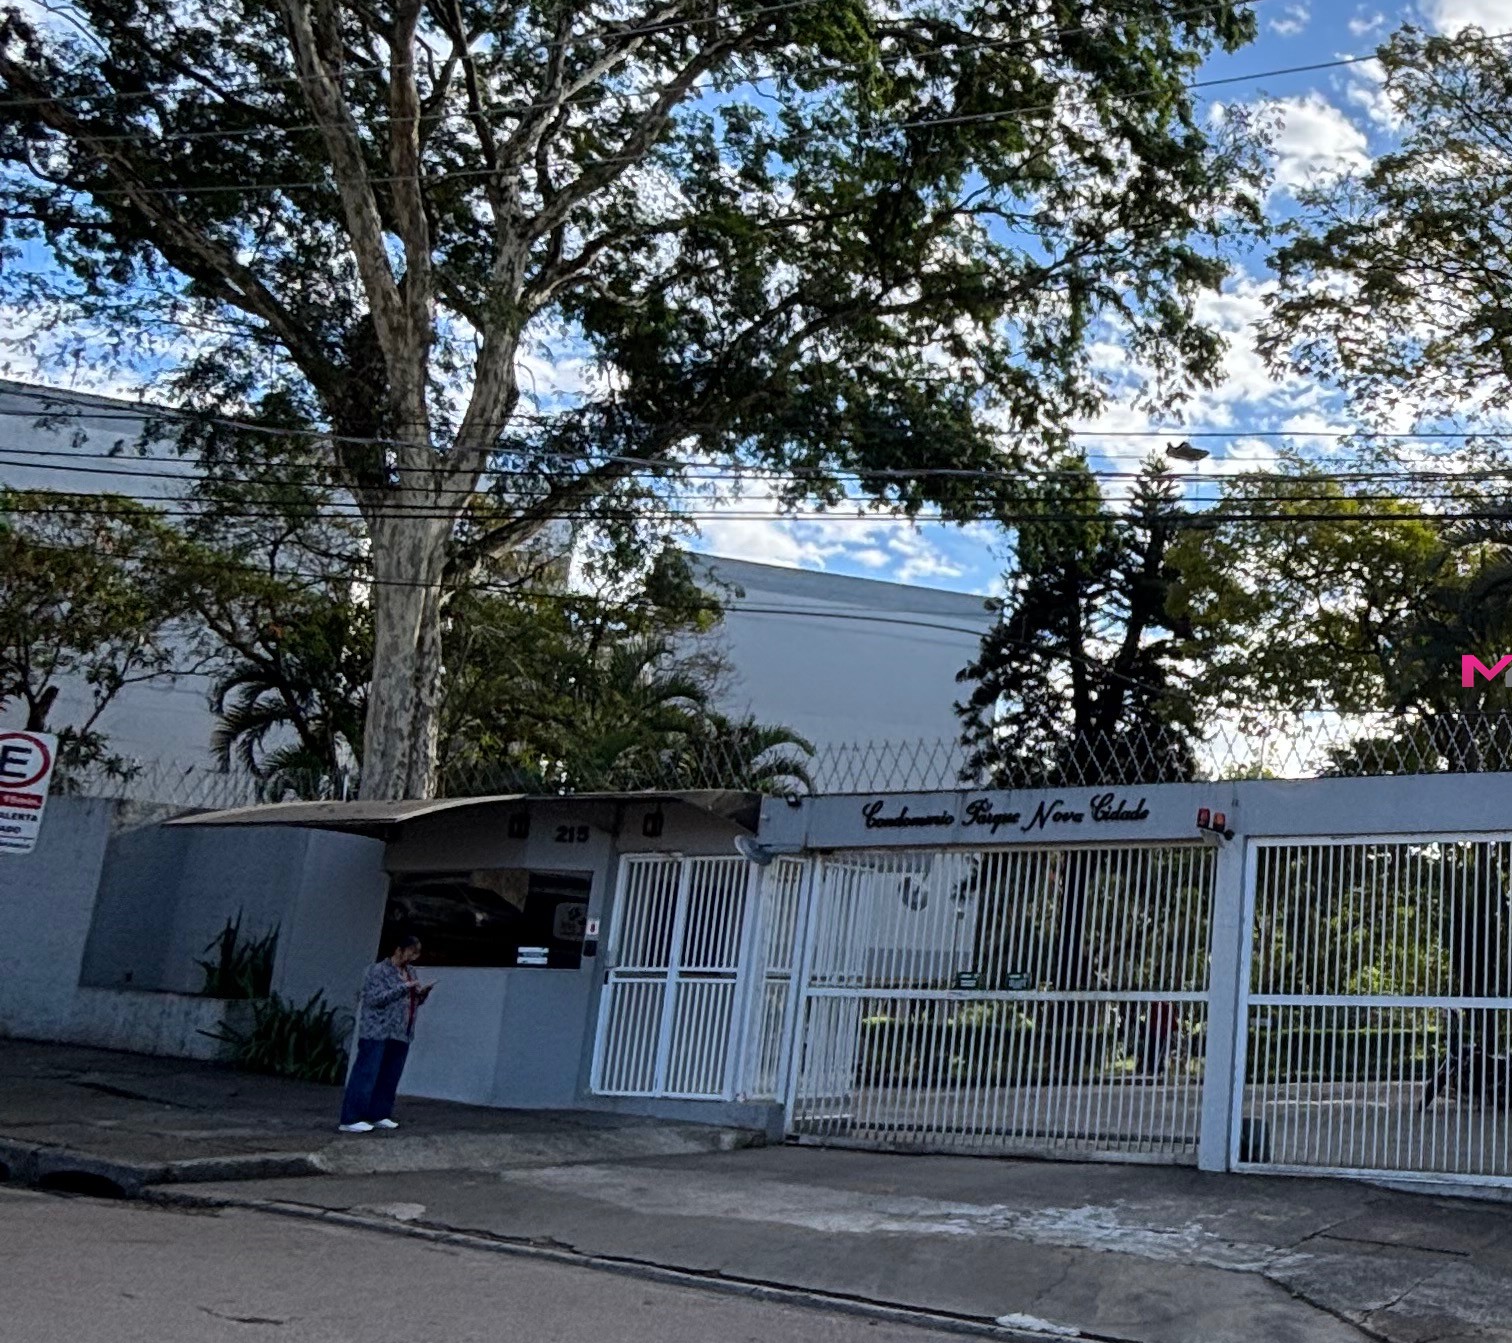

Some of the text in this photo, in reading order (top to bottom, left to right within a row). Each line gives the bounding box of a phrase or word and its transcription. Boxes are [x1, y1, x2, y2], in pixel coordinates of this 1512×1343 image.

[0, 744, 33, 778] E
[961, 797, 1020, 834] Parque
[1020, 799, 1084, 833] Nova
[1090, 792, 1150, 822] Cidade
